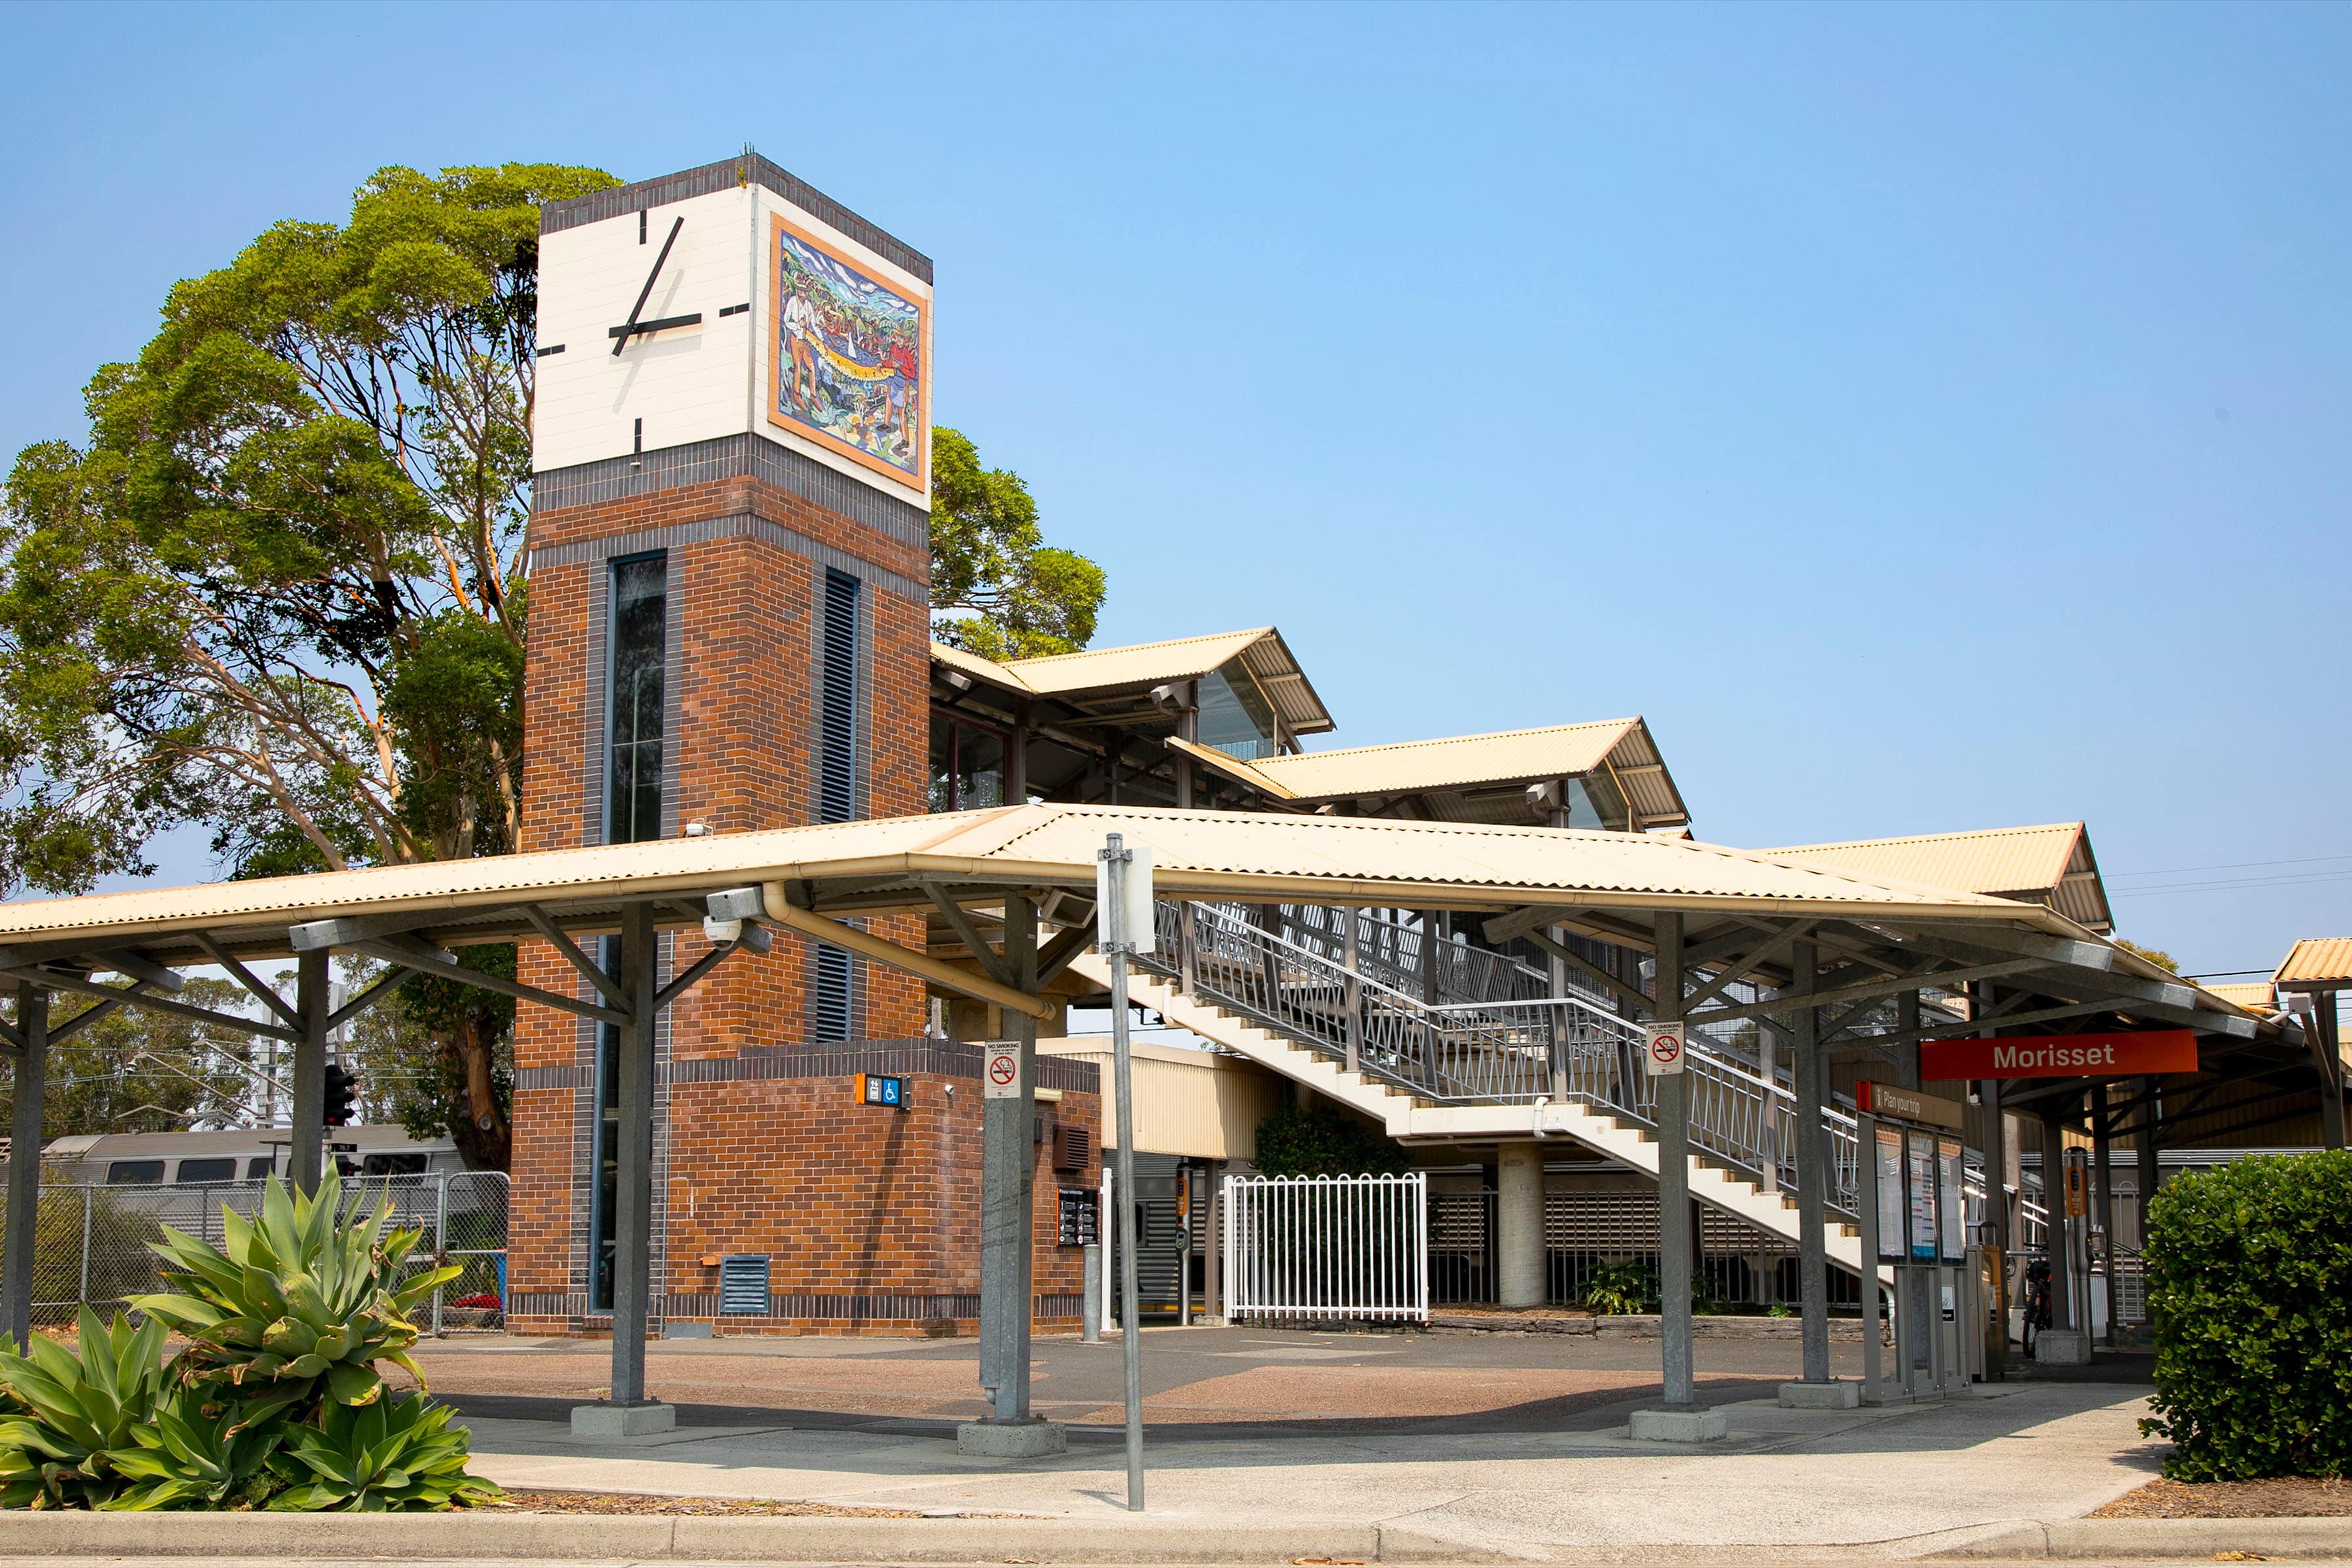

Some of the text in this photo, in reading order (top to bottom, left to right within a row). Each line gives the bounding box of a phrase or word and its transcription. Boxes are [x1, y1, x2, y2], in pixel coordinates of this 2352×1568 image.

[815, 341, 887, 378] MORSSET
[1994, 1043, 2115, 1069] Morisset
[1884, 1090, 1897, 1109] Plan
[1897, 1097, 1909, 1113] your
[1910, 1097, 1920, 1118] trip
